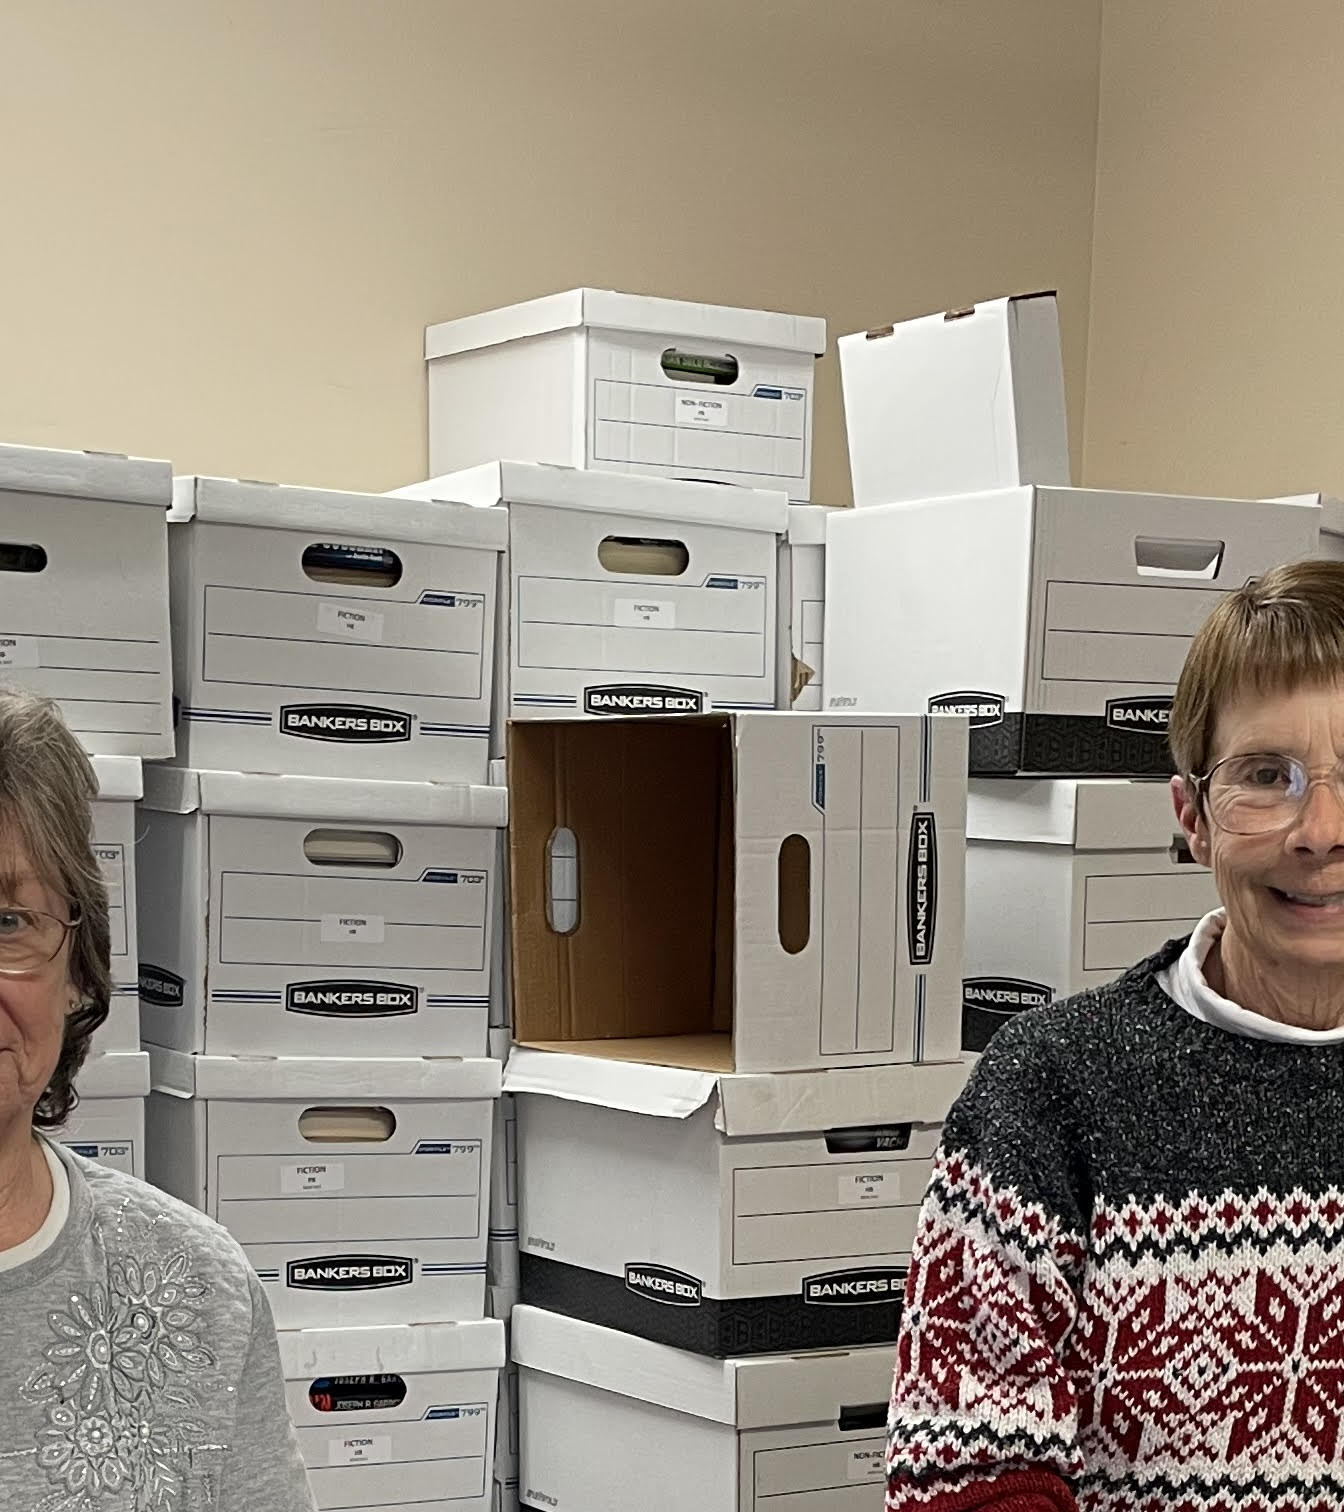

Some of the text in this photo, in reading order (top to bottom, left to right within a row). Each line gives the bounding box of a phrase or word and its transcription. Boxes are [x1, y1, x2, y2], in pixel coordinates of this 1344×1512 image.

[591, 694, 697, 710] BANKERS BOX
[288, 713, 405, 733] BANKERS BOX
[1113, 709, 1169, 723] BANKE
[916, 820, 928, 957] BANKERS BOX
[294, 991, 411, 1006] BANKERS BOX
[965, 987, 1046, 1004] BANKERS BOX
[297, 1165, 326, 1174] FICTION
[294, 1263, 406, 1280] BANKERS BOX
[629, 1271, 698, 1299] BANKERS BOX
[809, 1279, 908, 1297] BANKERS BO
[344, 1439, 373, 1448] FICTION
